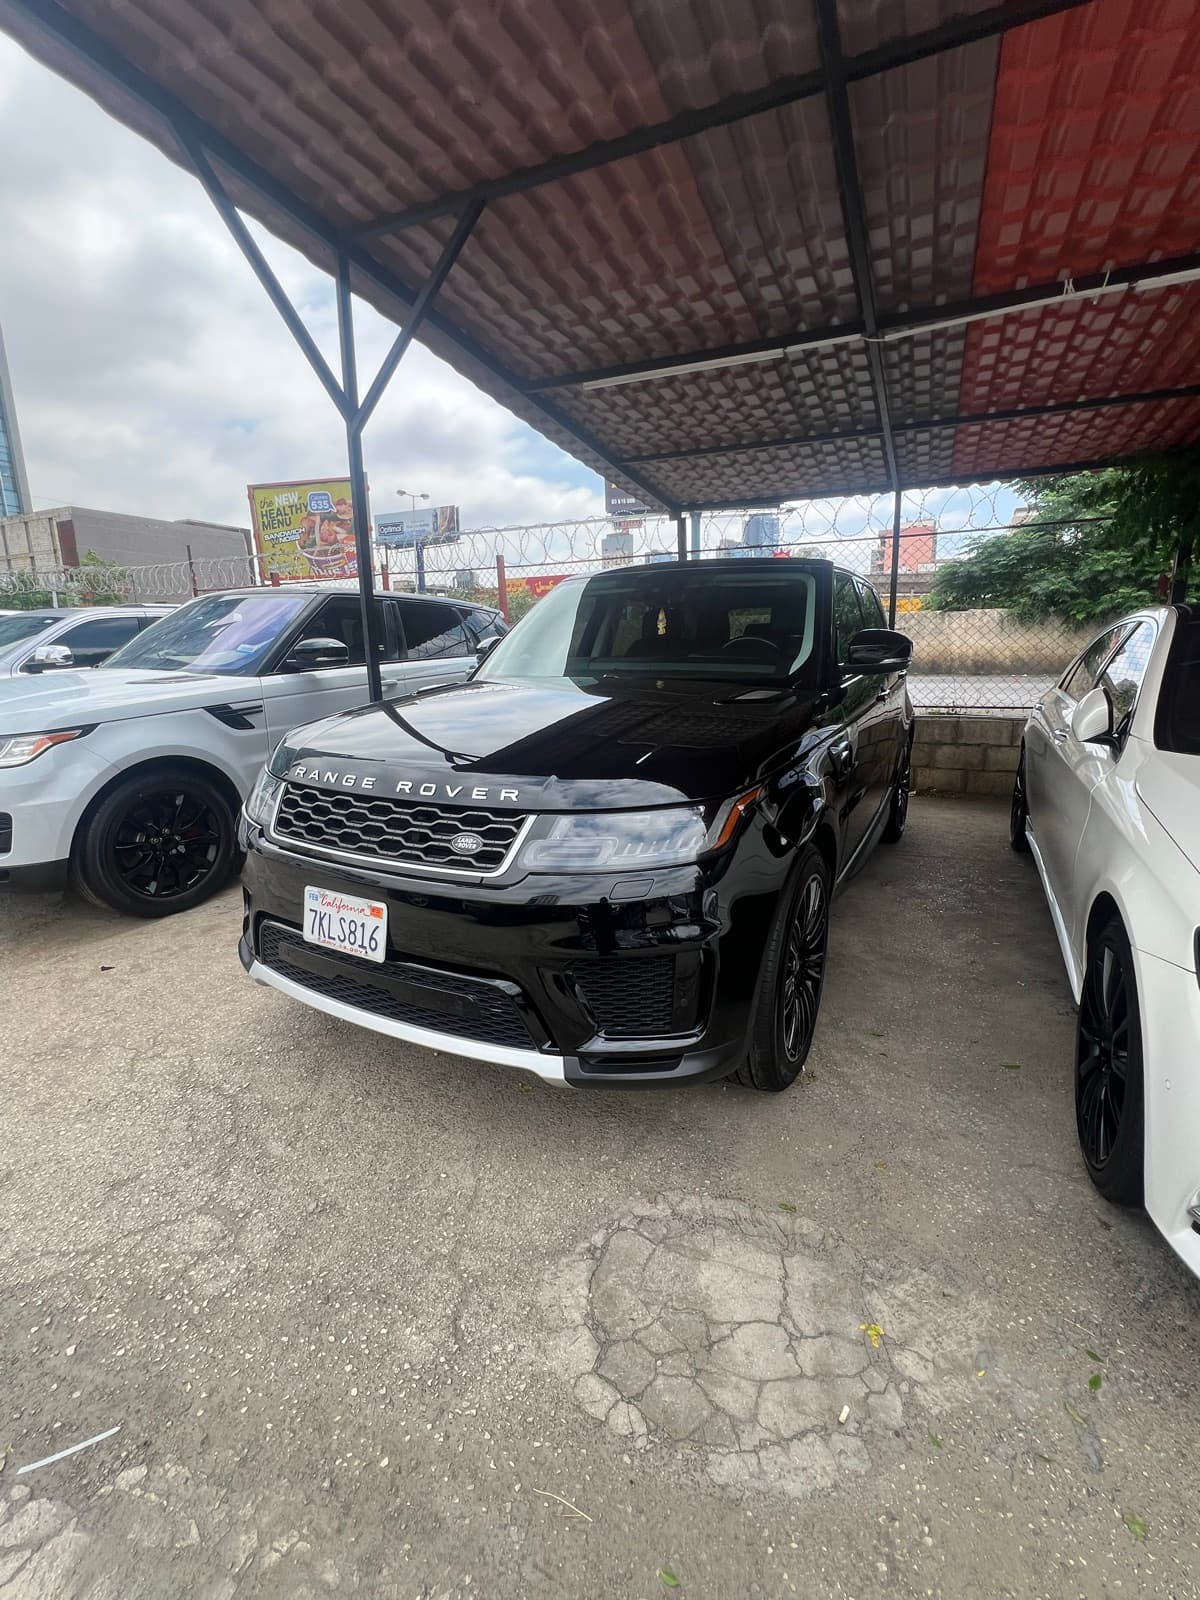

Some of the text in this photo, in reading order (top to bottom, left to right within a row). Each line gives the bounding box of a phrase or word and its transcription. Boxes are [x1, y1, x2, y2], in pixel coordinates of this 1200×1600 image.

[274, 492, 299, 507] NEW
[261, 503, 309, 520] HEALTHY
[262, 517, 292, 531] MENU
[264, 527, 306, 541] SANDWICH
[295, 766, 519, 802] RANGE ROVER
[321, 895, 366, 914] California
[309, 908, 380, 952] 7KLS816
